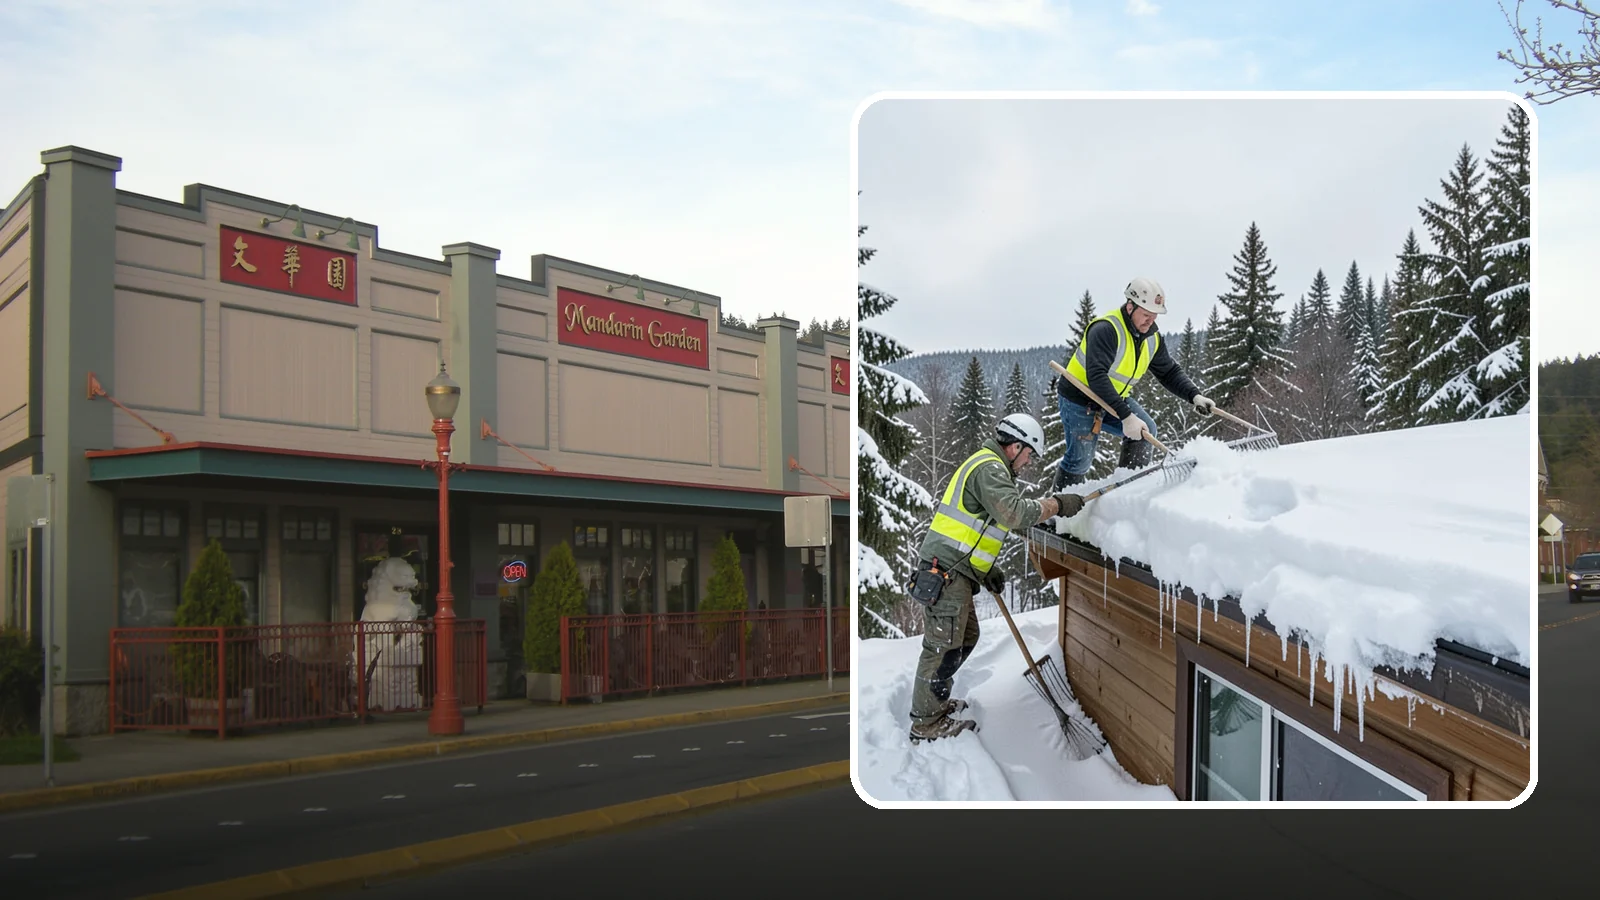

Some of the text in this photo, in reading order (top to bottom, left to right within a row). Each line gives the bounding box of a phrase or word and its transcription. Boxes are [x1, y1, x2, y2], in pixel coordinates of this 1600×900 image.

[230, 235, 346, 291] 文華園
[564, 301, 702, 353] Mandarin Garden
[503, 565, 527, 579] OPEN
